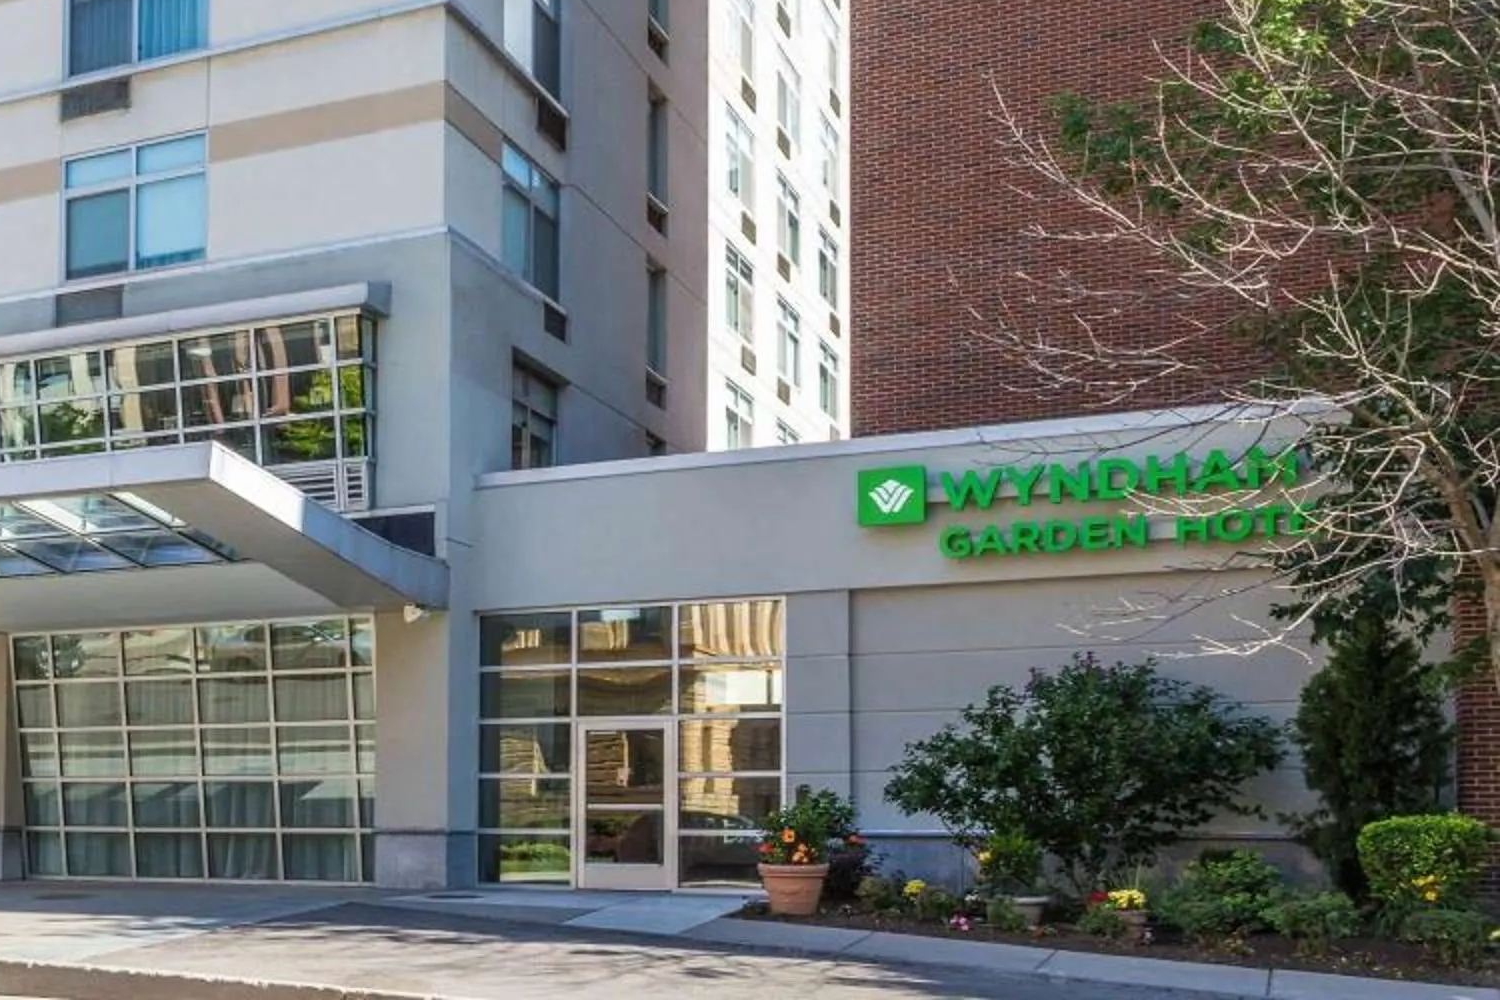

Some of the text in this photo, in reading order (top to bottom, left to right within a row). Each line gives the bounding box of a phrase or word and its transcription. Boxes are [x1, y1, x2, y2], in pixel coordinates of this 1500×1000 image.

[941, 446, 1300, 511] WYNDHAM
[940, 502, 1318, 560] GARDEN HOTE
